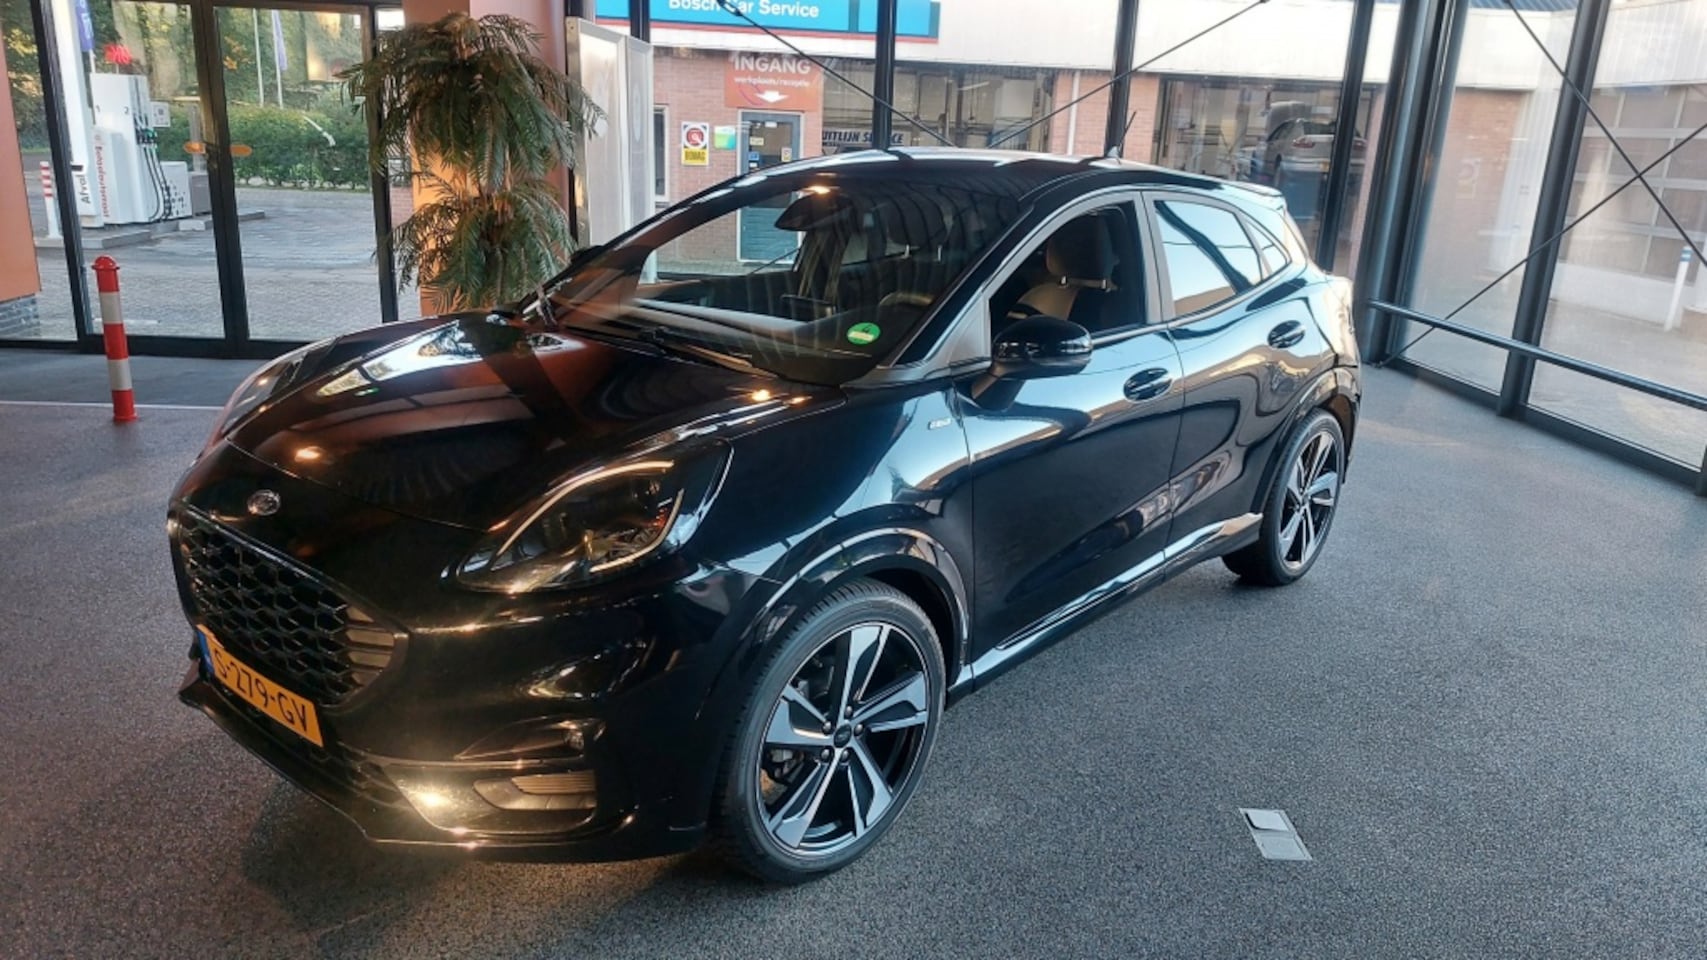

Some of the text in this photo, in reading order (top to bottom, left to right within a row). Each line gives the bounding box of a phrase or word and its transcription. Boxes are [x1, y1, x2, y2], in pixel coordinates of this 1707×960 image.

[668, 0, 720, 11] Bosch
[758, 1, 819, 18] Service
[734, 55, 811, 75] INGANG
[124, 106, 129, 115] 2
[75, 174, 91, 204] Afval
[214, 647, 307, 732] S-279-GV
